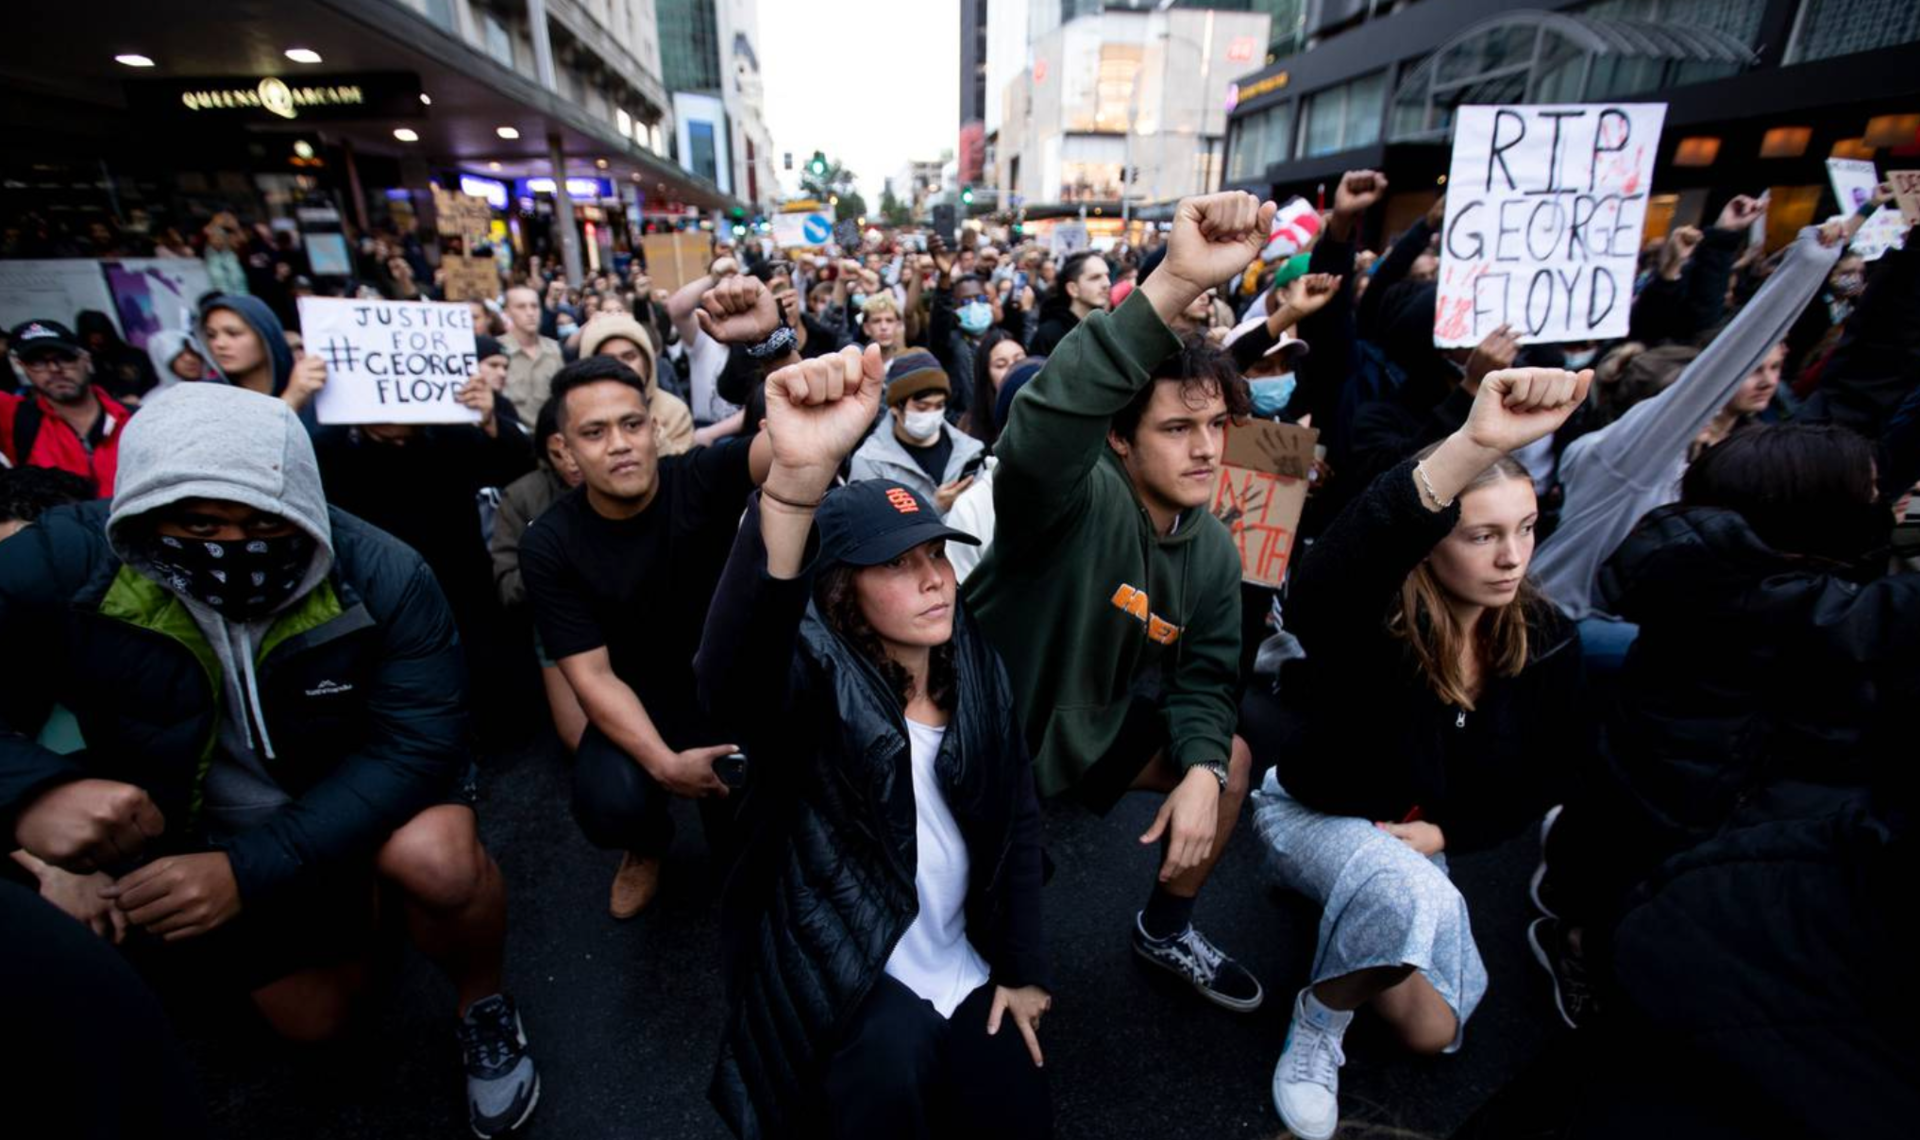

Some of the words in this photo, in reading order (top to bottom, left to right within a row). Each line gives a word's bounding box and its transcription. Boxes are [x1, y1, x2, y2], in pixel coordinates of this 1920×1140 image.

[182, 89, 262, 110] QUEENS
[292, 85, 363, 105] ARCADE
[1486, 108, 1631, 195] RIP
[1447, 193, 1643, 262] GEORGE
[353, 305, 469, 329] JUSTICE
[1473, 266, 1617, 336] FLOYD
[392, 331, 449, 351] FOR
